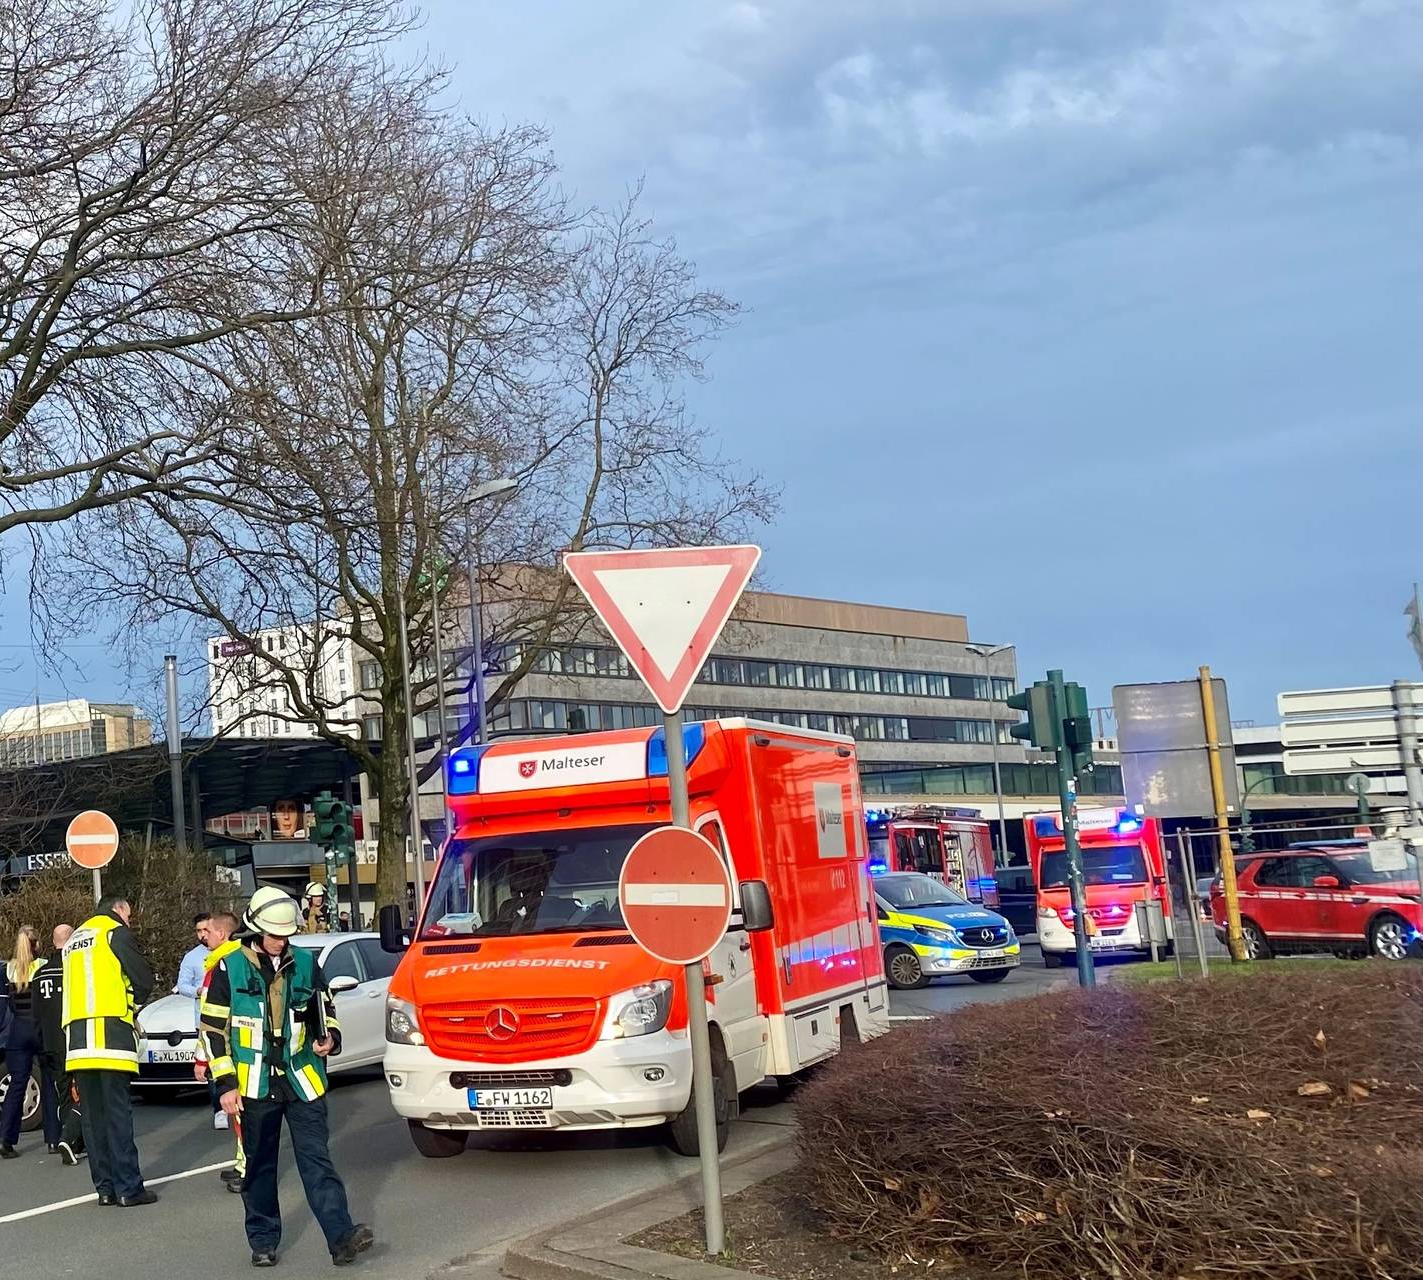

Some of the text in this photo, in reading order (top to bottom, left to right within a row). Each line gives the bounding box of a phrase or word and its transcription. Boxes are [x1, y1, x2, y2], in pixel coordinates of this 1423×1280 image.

[542, 756, 605, 771] Malteser
[424, 958, 610, 979] RETTUNGSDIENST
[514, 1091, 550, 1105] 1162
